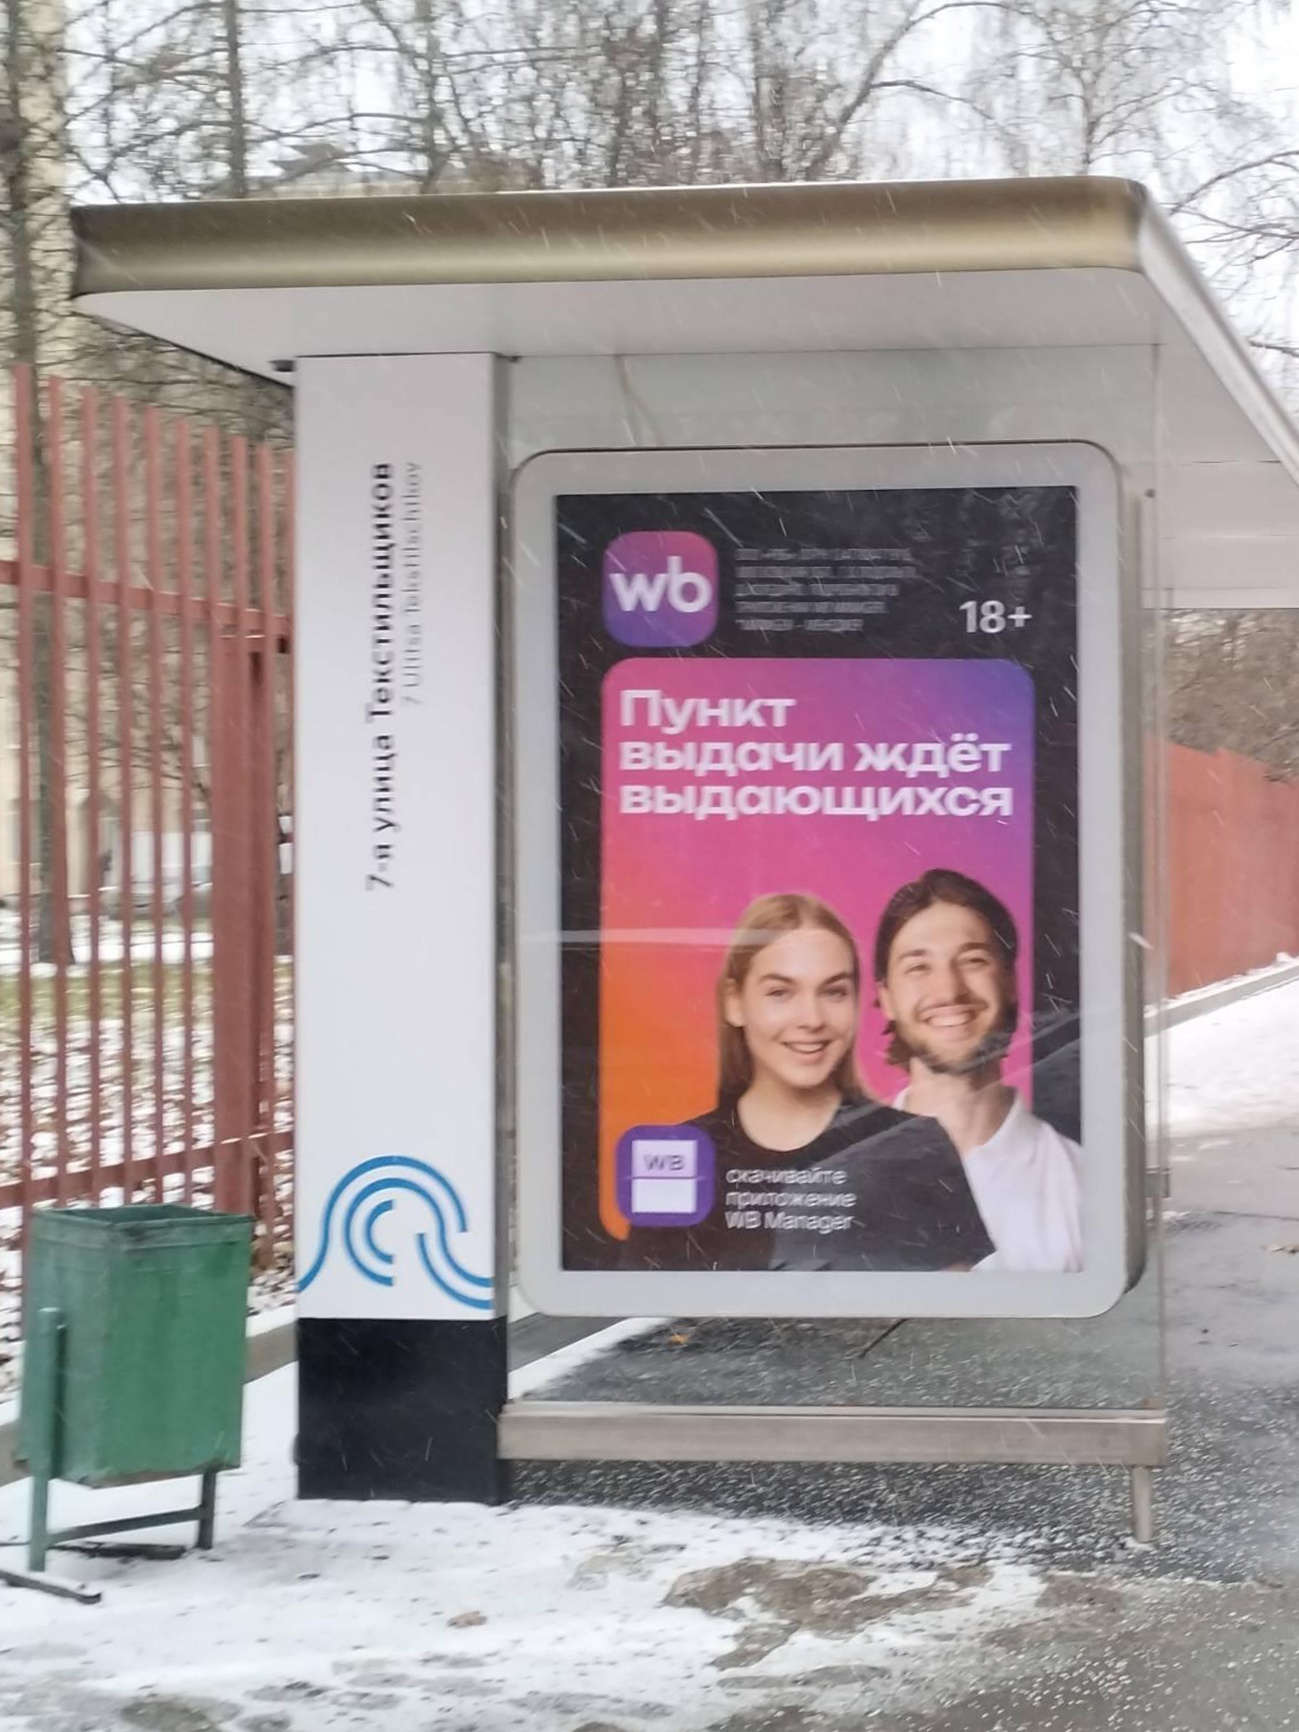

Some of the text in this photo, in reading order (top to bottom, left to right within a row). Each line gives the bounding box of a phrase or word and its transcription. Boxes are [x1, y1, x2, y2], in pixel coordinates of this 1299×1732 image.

[609, 556, 712, 613] wb
[959, 600, 1032, 634] 18+
[365, 463, 401, 891] 7-я улица Текстильщиков
[619, 690, 796, 734] Пункт
[619, 733, 1012, 779] выдачи ждёт
[619, 785, 1014, 821] выдающихся
[643, 1154, 685, 1171] WB
[725, 1167, 847, 1184] скачивайте
[725, 1191, 857, 1210] приложение
[725, 1211, 854, 1234] WB Manager
